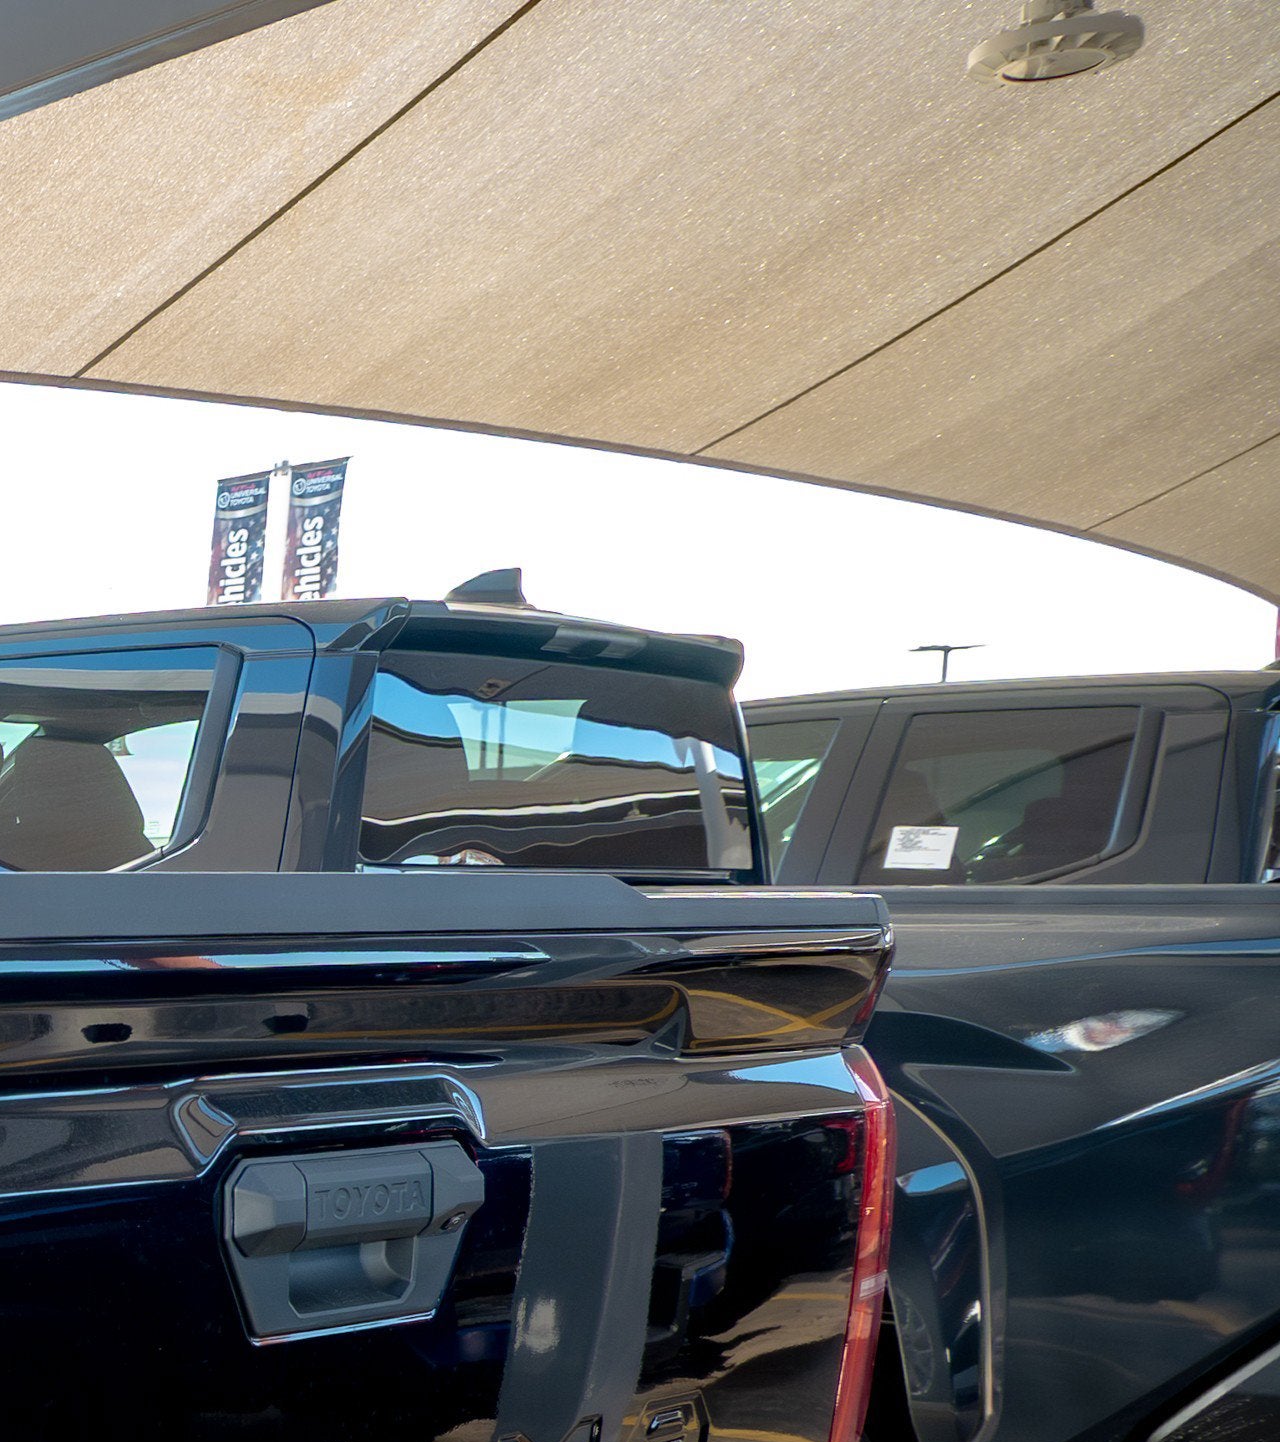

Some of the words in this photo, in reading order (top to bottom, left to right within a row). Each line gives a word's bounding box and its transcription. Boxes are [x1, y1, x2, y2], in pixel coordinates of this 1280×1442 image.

[218, 528, 249, 604] hicles
[294, 516, 324, 600] ehicles
[314, 1180, 428, 1221] TOYOTA
